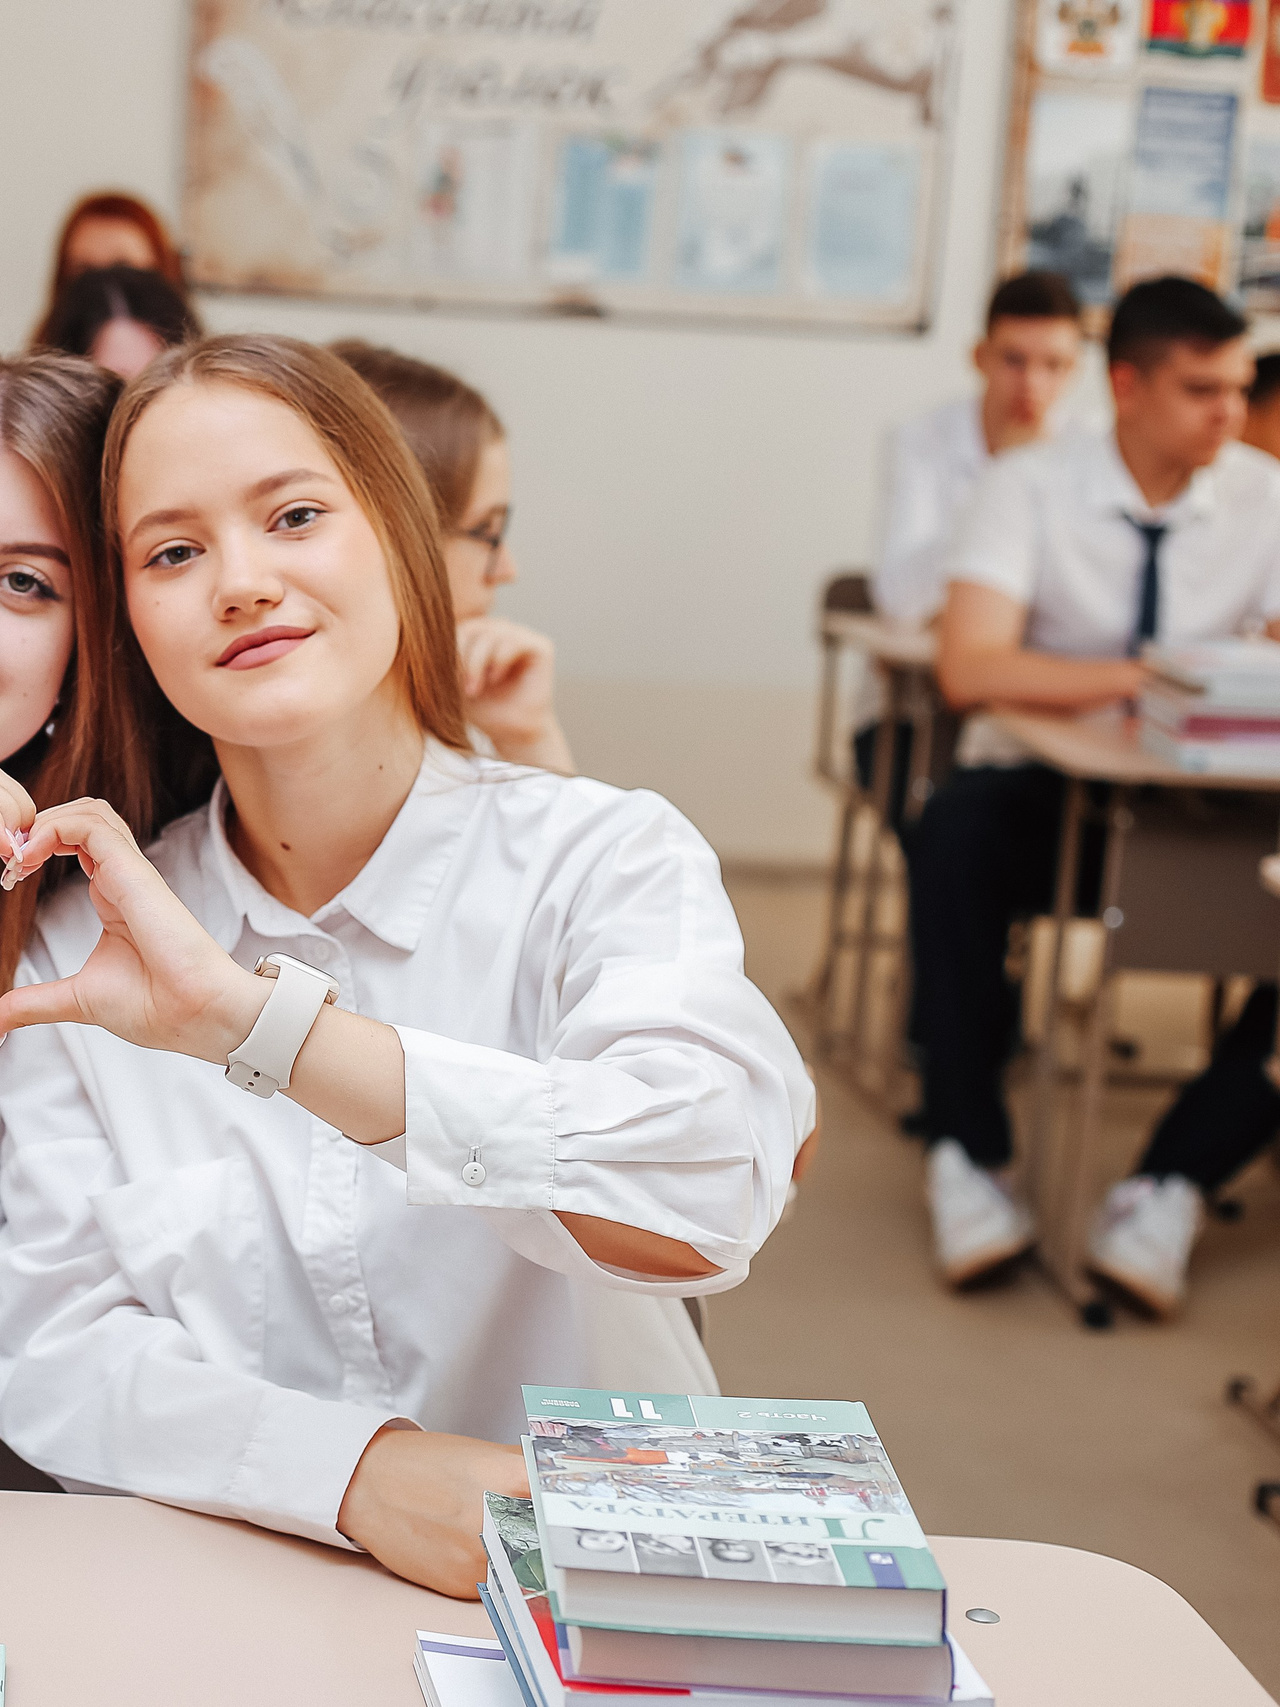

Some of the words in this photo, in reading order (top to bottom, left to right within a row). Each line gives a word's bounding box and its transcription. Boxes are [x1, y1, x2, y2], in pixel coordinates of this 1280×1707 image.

[609, 1397, 663, 1421] 11
[737, 1410, 753, 1419] 2
[756, 1411, 828, 1422] Часть
